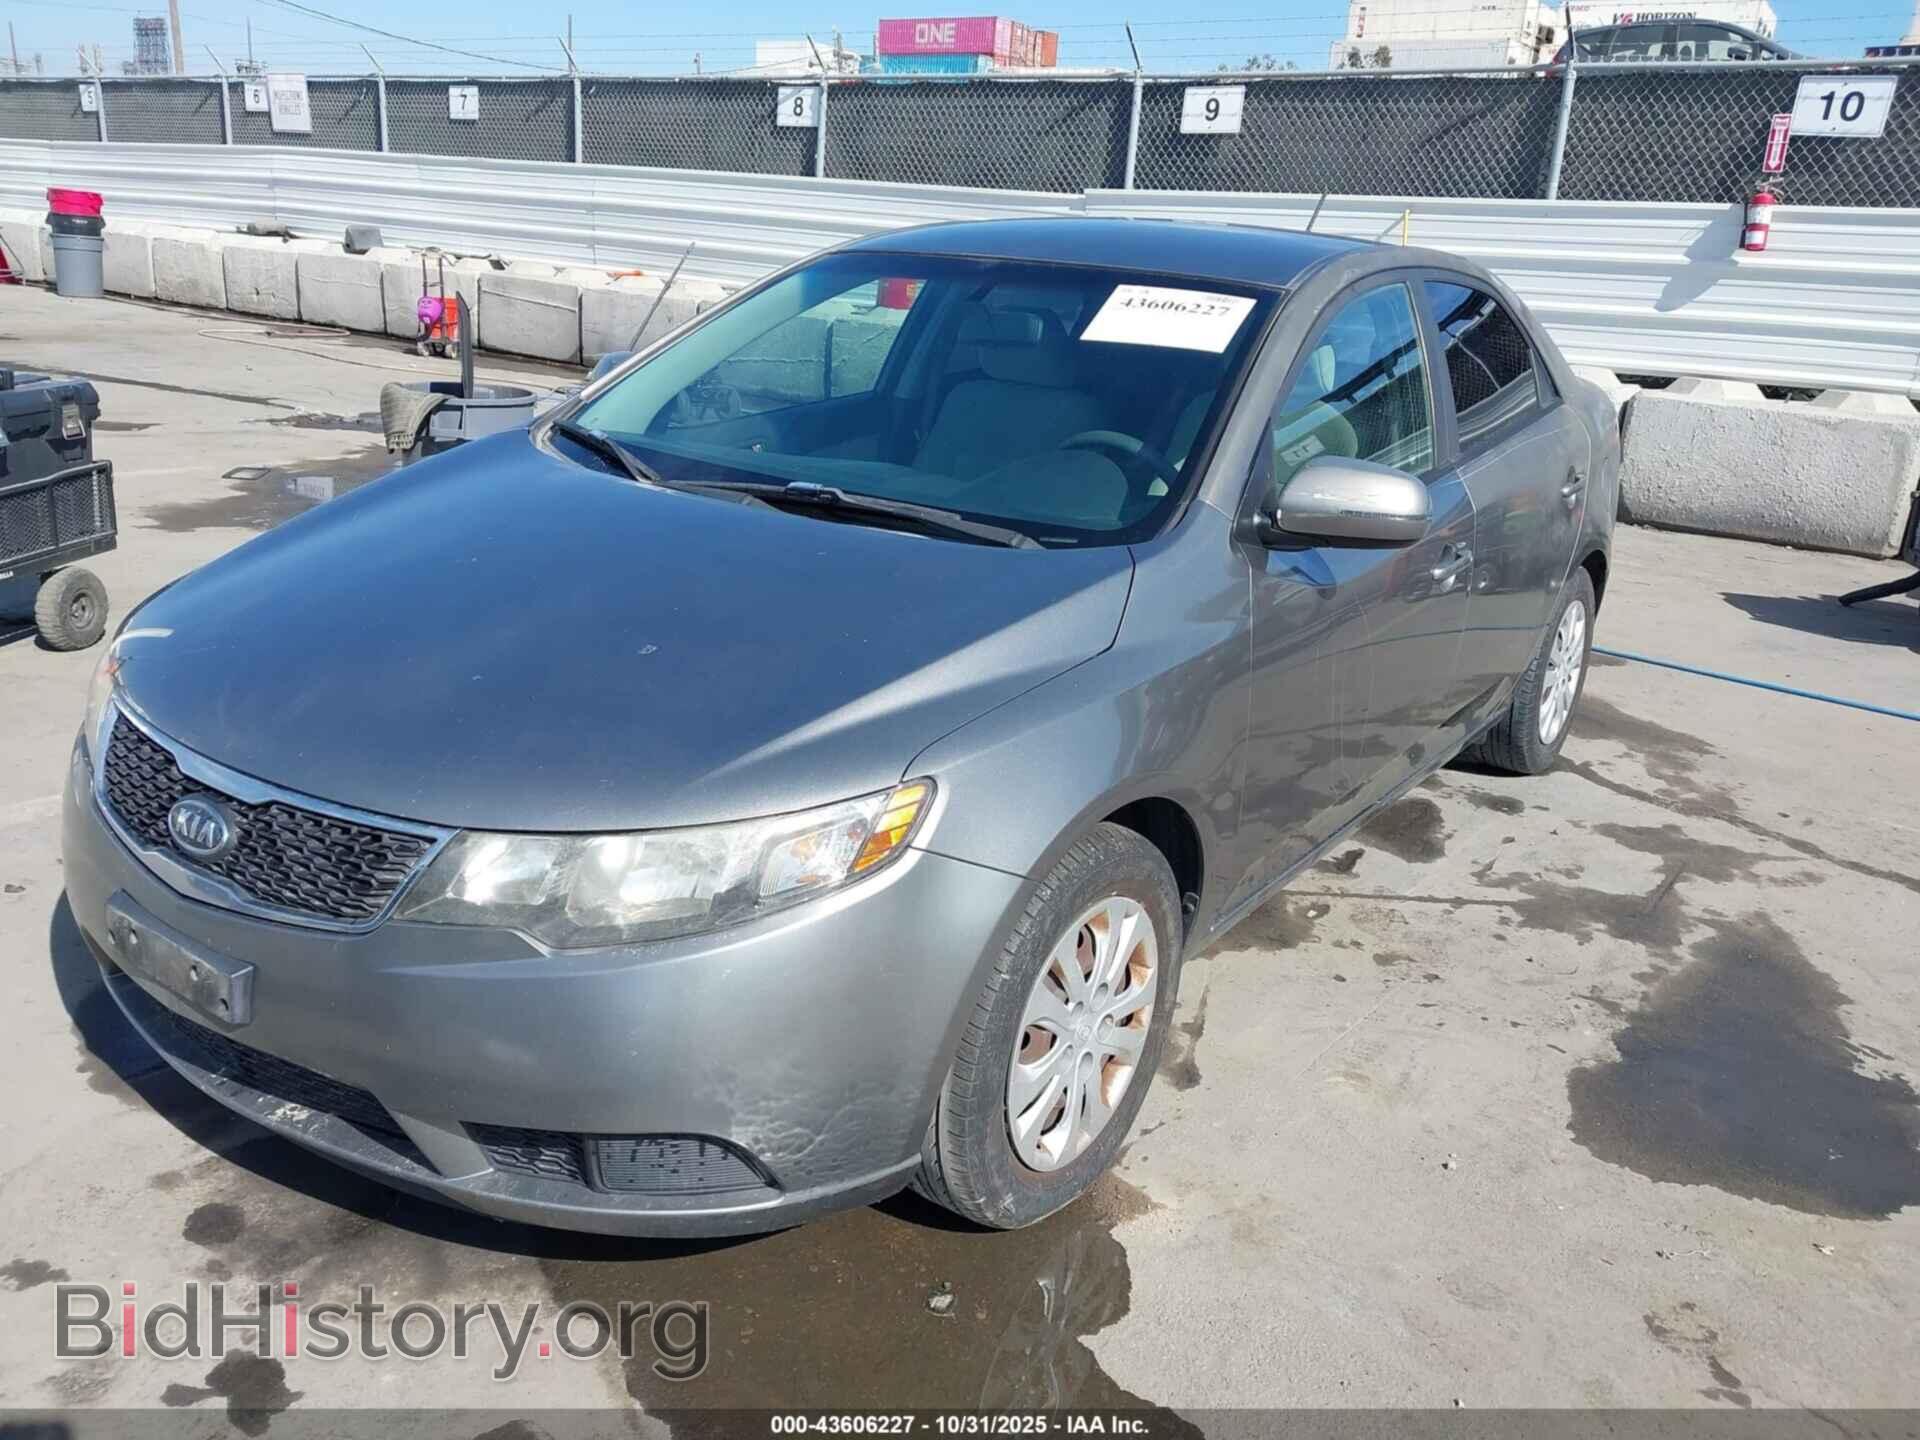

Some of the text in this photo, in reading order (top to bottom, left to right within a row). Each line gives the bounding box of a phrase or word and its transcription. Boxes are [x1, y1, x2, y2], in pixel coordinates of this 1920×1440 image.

[1636, 12, 1697, 24] HORIZON
[915, 23, 956, 43] ONE
[87, 91, 94, 105] 5
[252, 89, 260, 104] 6
[459, 94, 467, 111] 7
[1820, 91, 1865, 121] 10
[793, 97, 804, 117] 8
[1205, 98, 1220, 121] 9
[1120, 297, 1231, 317] 43606227
[175, 807, 216, 849] KIA
